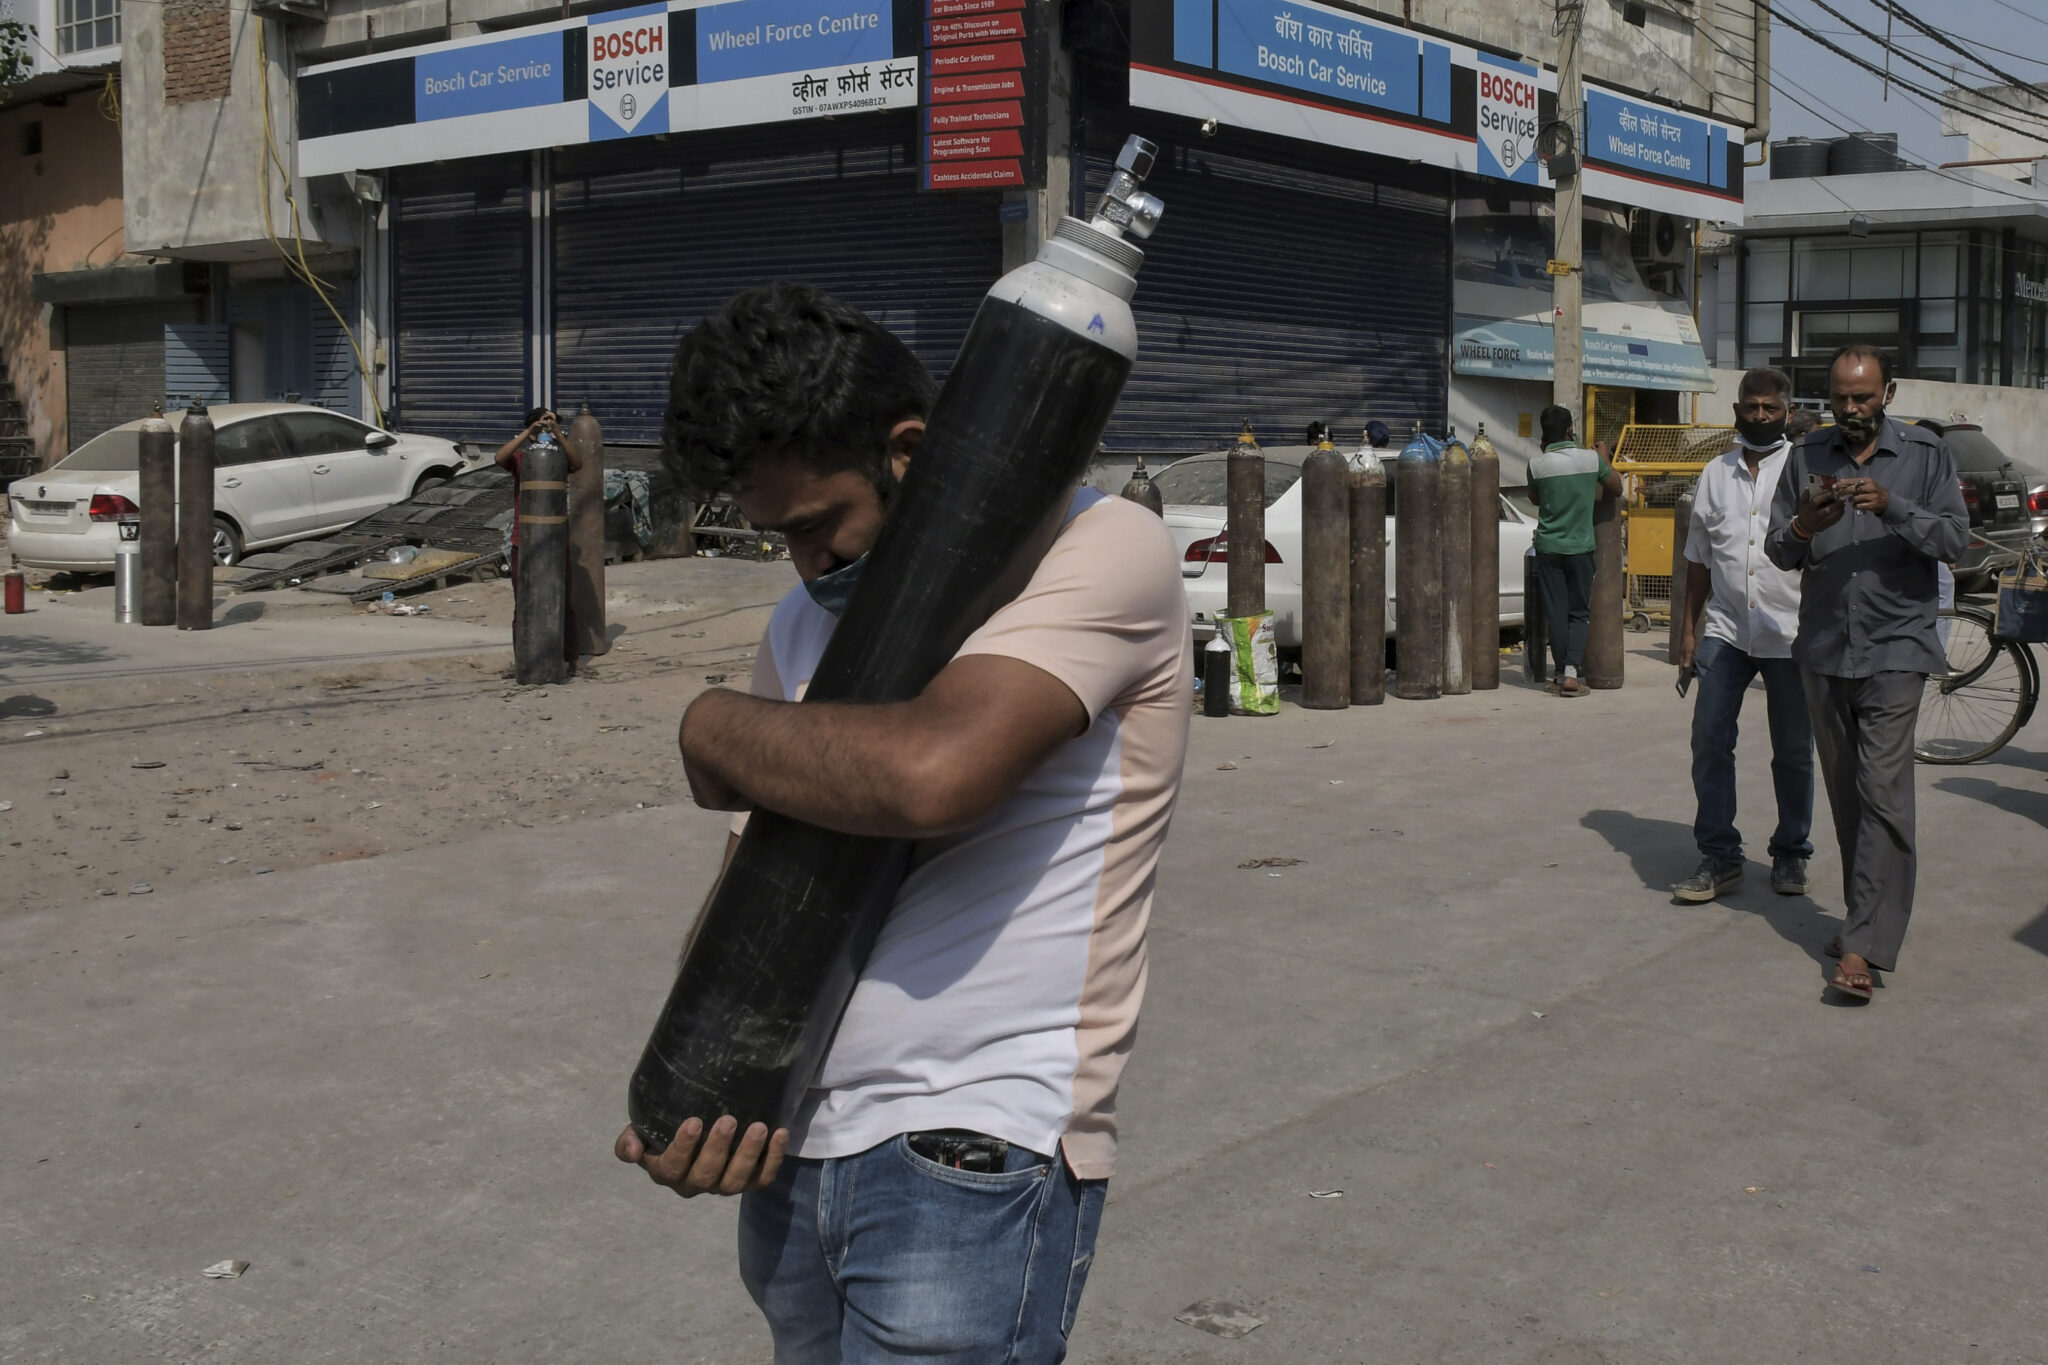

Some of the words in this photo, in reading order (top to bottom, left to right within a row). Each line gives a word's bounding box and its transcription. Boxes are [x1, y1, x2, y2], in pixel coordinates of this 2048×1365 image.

[964, 2, 980, 10] Since
[709, 26, 760, 51] Wheel
[765, 22, 812, 43] Force
[818, 12, 878, 35] Centre
[933, 33, 958, 42] Original
[959, 31, 975, 39] Parts
[989, 27, 1017, 36] Warranty
[964, 21, 991, 29] Discount
[593, 26, 663, 61] BOSCH
[1274, 11, 1303, 42] बॉश
[1307, 23, 1333, 50] कार
[1337, 28, 1373, 61] सर्विस
[935, 57, 959, 65] Periodic
[959, 55, 969, 63] Car
[970, 54, 995, 62] Services
[425, 72, 465, 96] Bosch
[469, 69, 494, 88] Car
[497, 60, 551, 84] Service
[593, 61, 664, 91] Service
[1258, 45, 1304, 77] Bosch
[1308, 58, 1333, 83] Car
[1337, 65, 1386, 96] Service
[792, 73, 829, 102] व्हील
[879, 63, 915, 90] सेंटर
[934, 86, 955, 95] Engine
[962, 82, 1001, 91] Transmission
[1001, 81, 1015, 89] Jobs
[1480, 72, 1535, 110] BOSCH
[792, 105, 814, 116] GSTIN
[933, 116, 949, 125] Fully
[949, 113, 973, 122] Trained
[973, 112, 1010, 121] Technicians
[1618, 106, 1638, 132] व्हील
[1480, 104, 1535, 139] Service
[933, 138, 952, 147] Latest
[953, 136, 980, 145] Software
[933, 147, 975, 157] Programming
[1608, 135, 1637, 159] Wheel
[1638, 143, 1663, 165] Force
[1664, 148, 1691, 171] Centre
[933, 174, 960, 182] Cashless
[960, 171, 993, 180] Accidental
[993, 170, 1015, 178] Claims
[1460, 344, 1491, 359] WHEEL
[1492, 347, 1521, 361] FORCE
